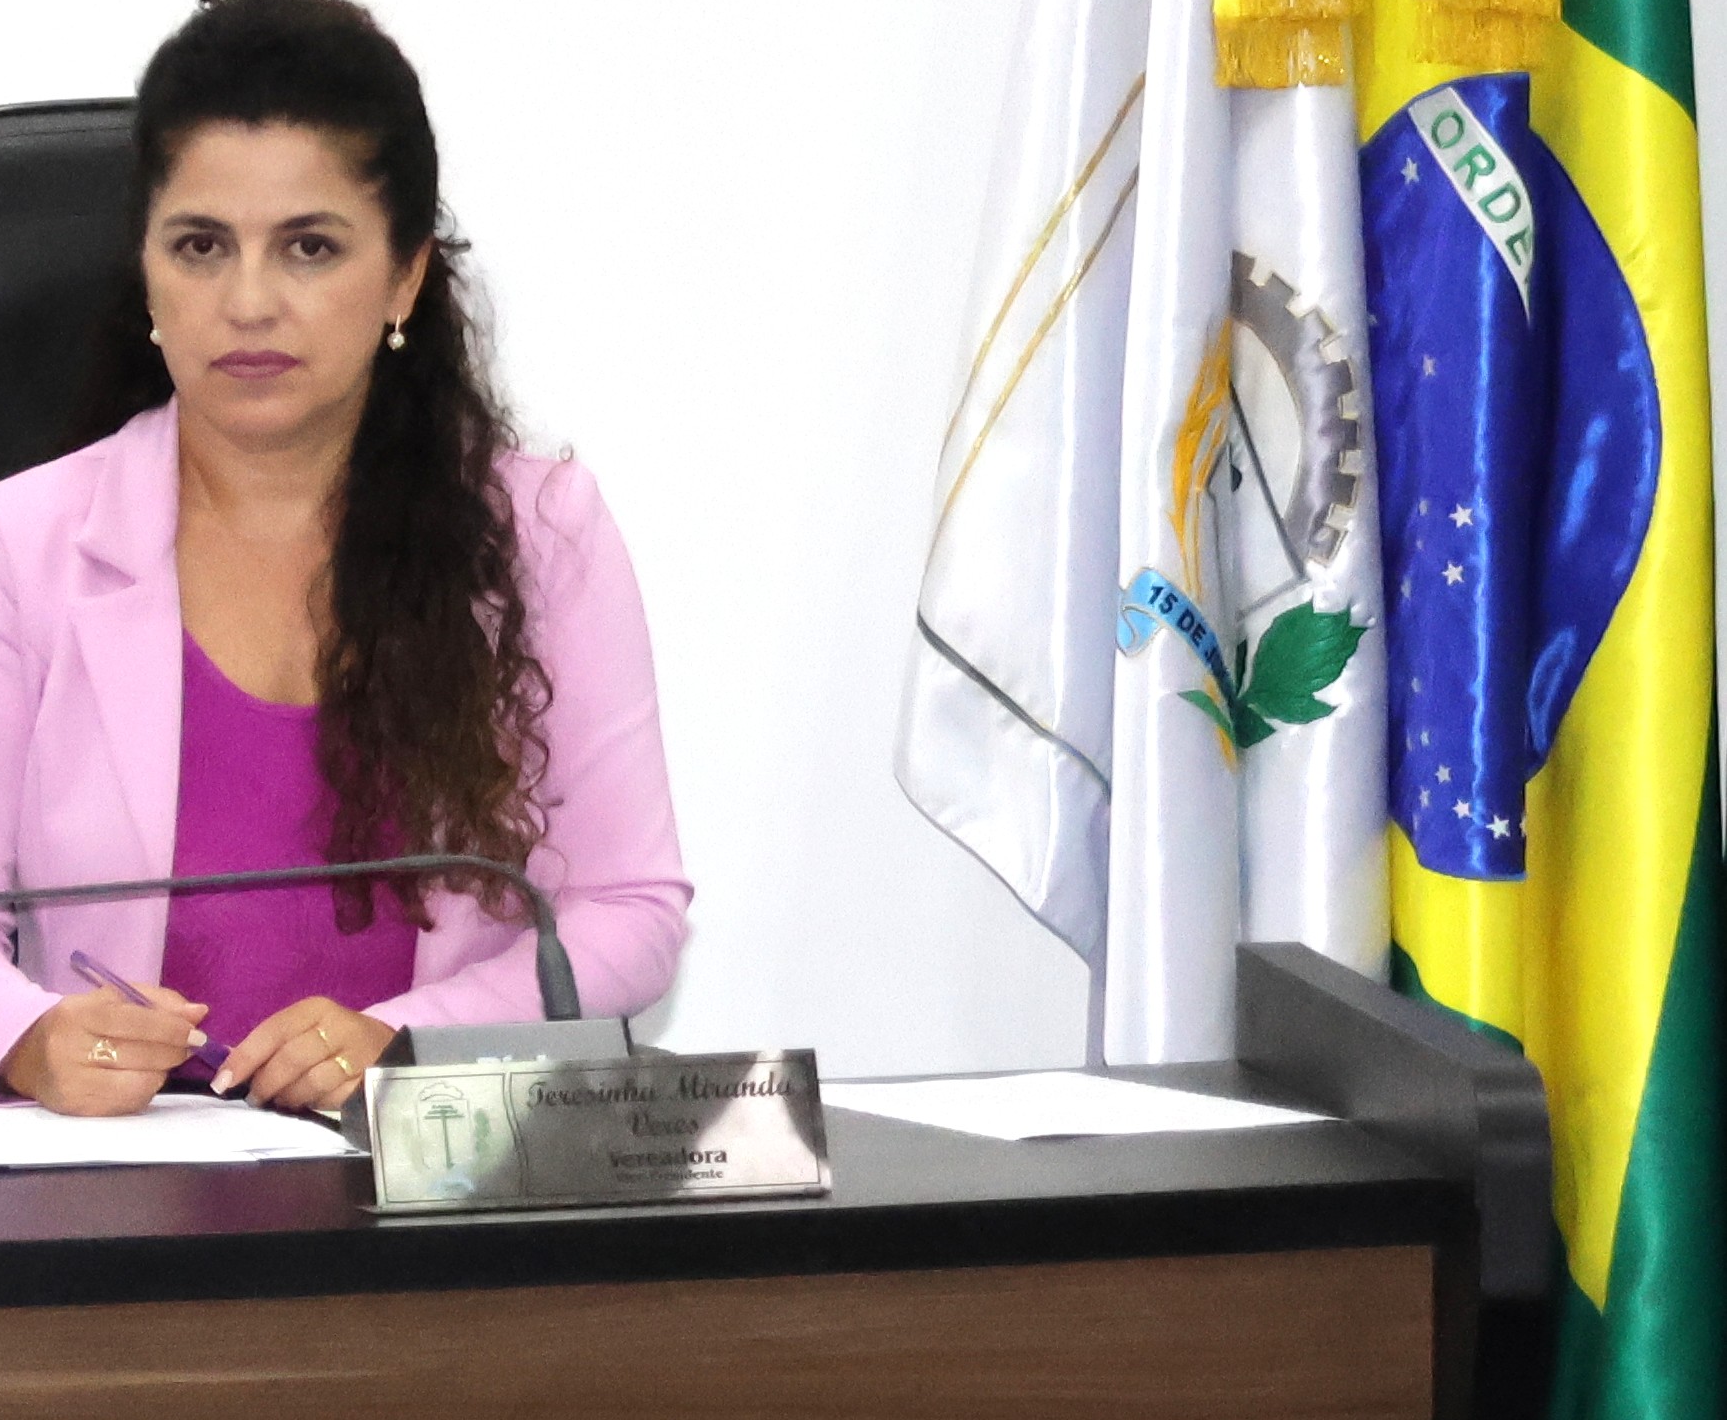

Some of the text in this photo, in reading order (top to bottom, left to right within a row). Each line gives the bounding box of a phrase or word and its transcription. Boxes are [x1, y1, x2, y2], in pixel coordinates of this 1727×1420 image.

[1147, 585, 1179, 614] 15
[1176, 608, 1207, 648] DE
[610, 1146, 728, 1168] Vereadora
